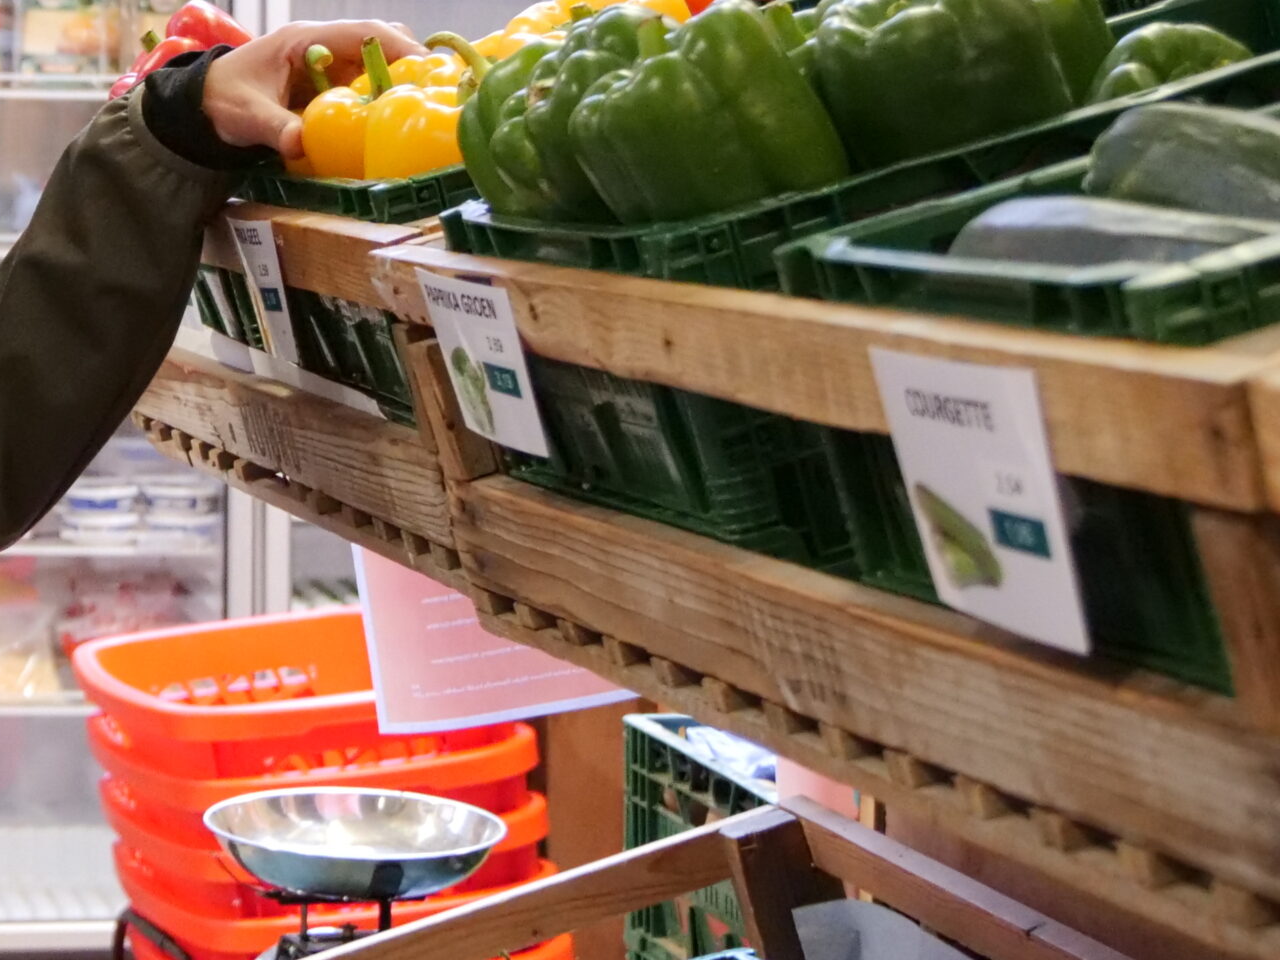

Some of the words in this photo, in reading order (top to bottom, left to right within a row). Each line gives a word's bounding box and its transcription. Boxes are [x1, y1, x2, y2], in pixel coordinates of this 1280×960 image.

[423, 283, 461, 313] PAPRIKA
[460, 292, 498, 321] GROEN
[904, 387, 995, 433] COURGETTE
